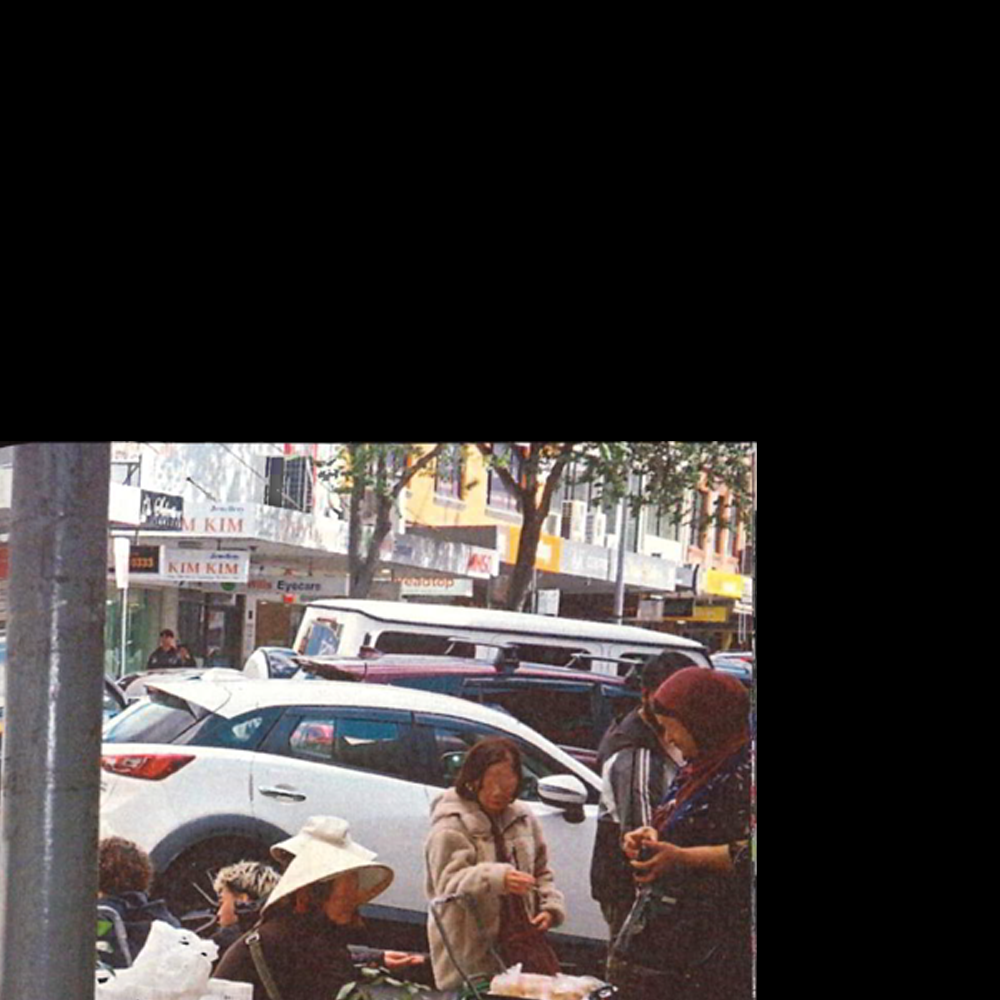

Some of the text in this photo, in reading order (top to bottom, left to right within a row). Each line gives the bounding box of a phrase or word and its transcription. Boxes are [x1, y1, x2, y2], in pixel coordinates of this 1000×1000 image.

[204, 517, 244, 533] KIM
[168, 562, 240, 575] KIM KIM
[277, 580, 321, 592] Eyecare
